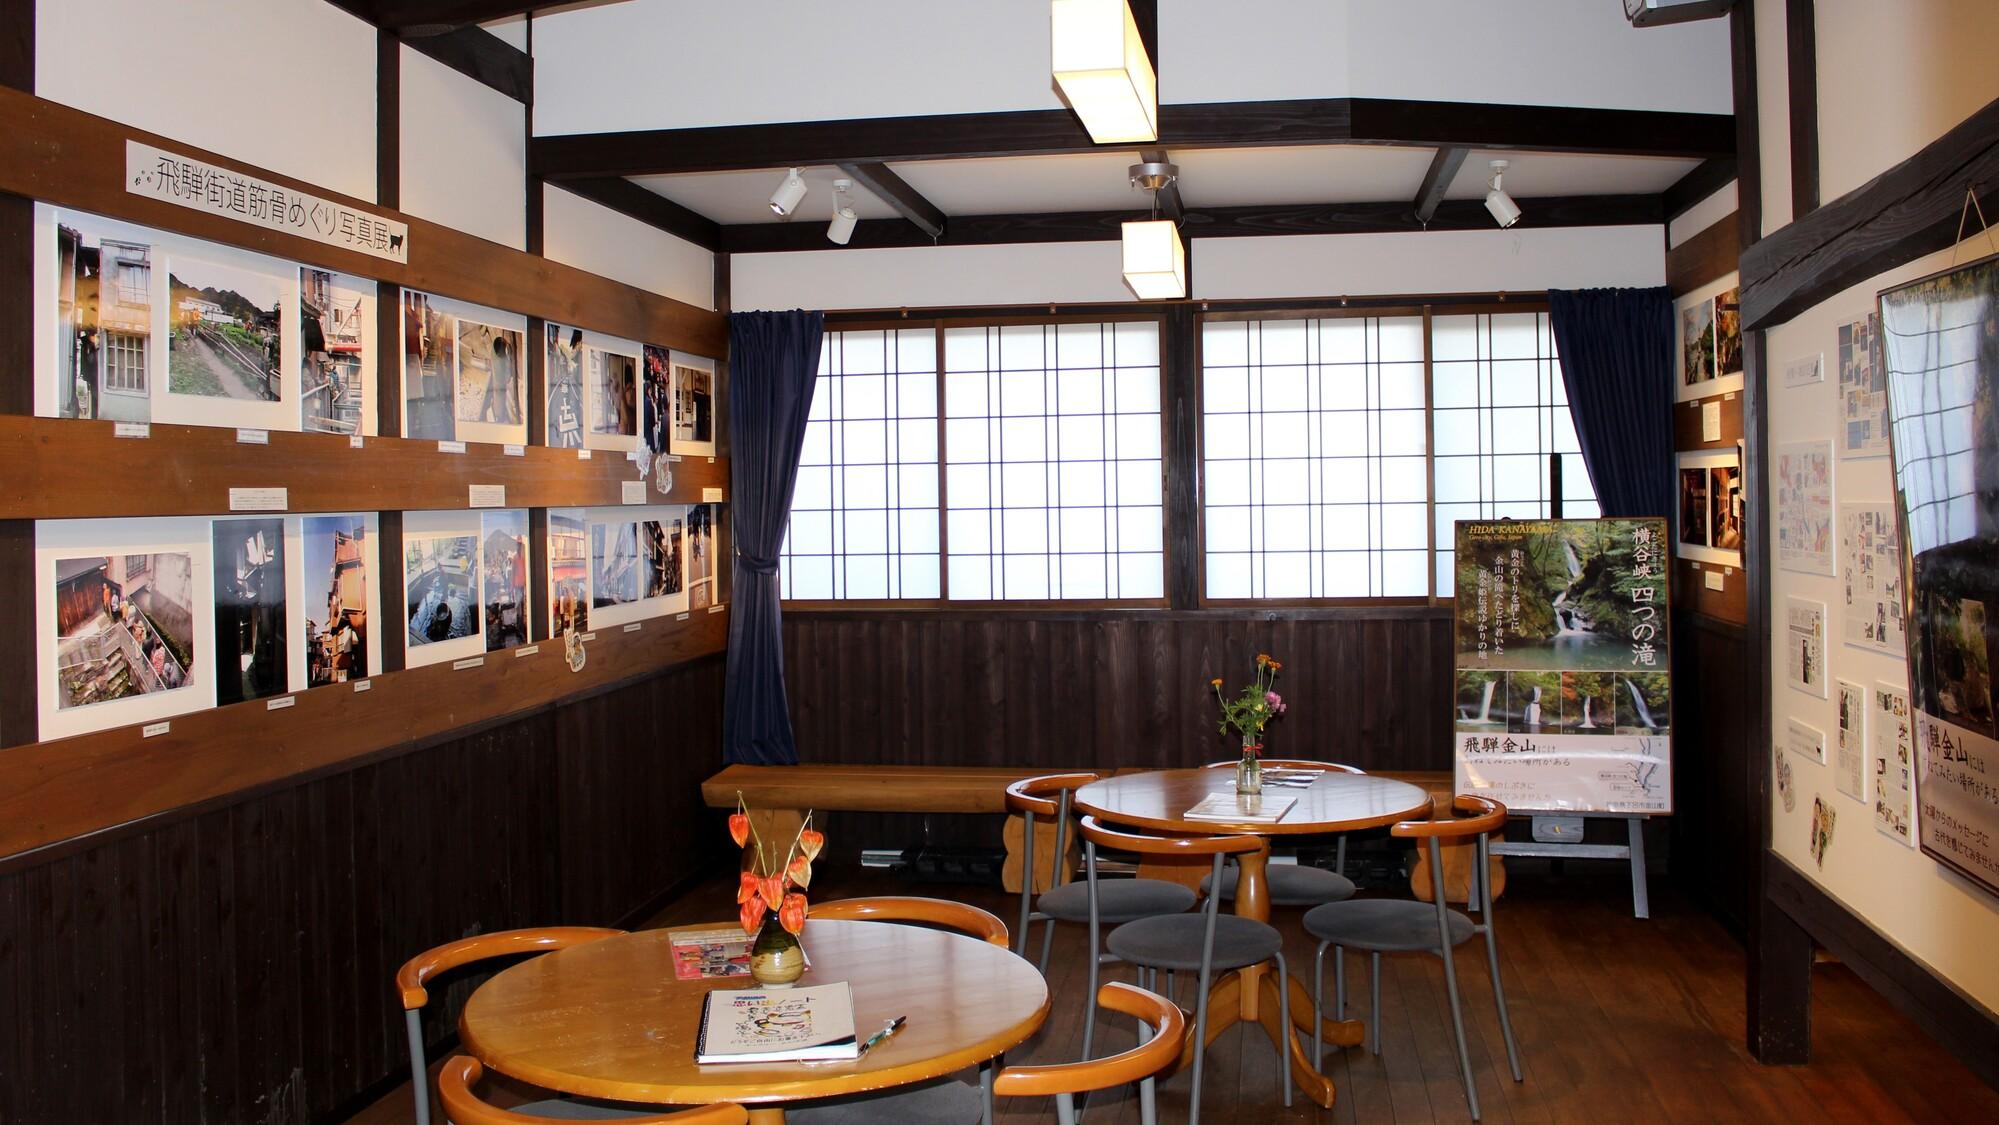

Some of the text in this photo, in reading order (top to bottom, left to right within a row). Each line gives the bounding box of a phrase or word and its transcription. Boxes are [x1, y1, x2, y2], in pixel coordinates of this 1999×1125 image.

[156, 155, 389, 254] 飛騨街道筋骨めぐり写真展
[1469, 525, 1495, 534] HIDA
[1632, 527, 1657, 666] 横谷峡 四つの滝
[1924, 758, 1999, 805] てみたい場所がある
